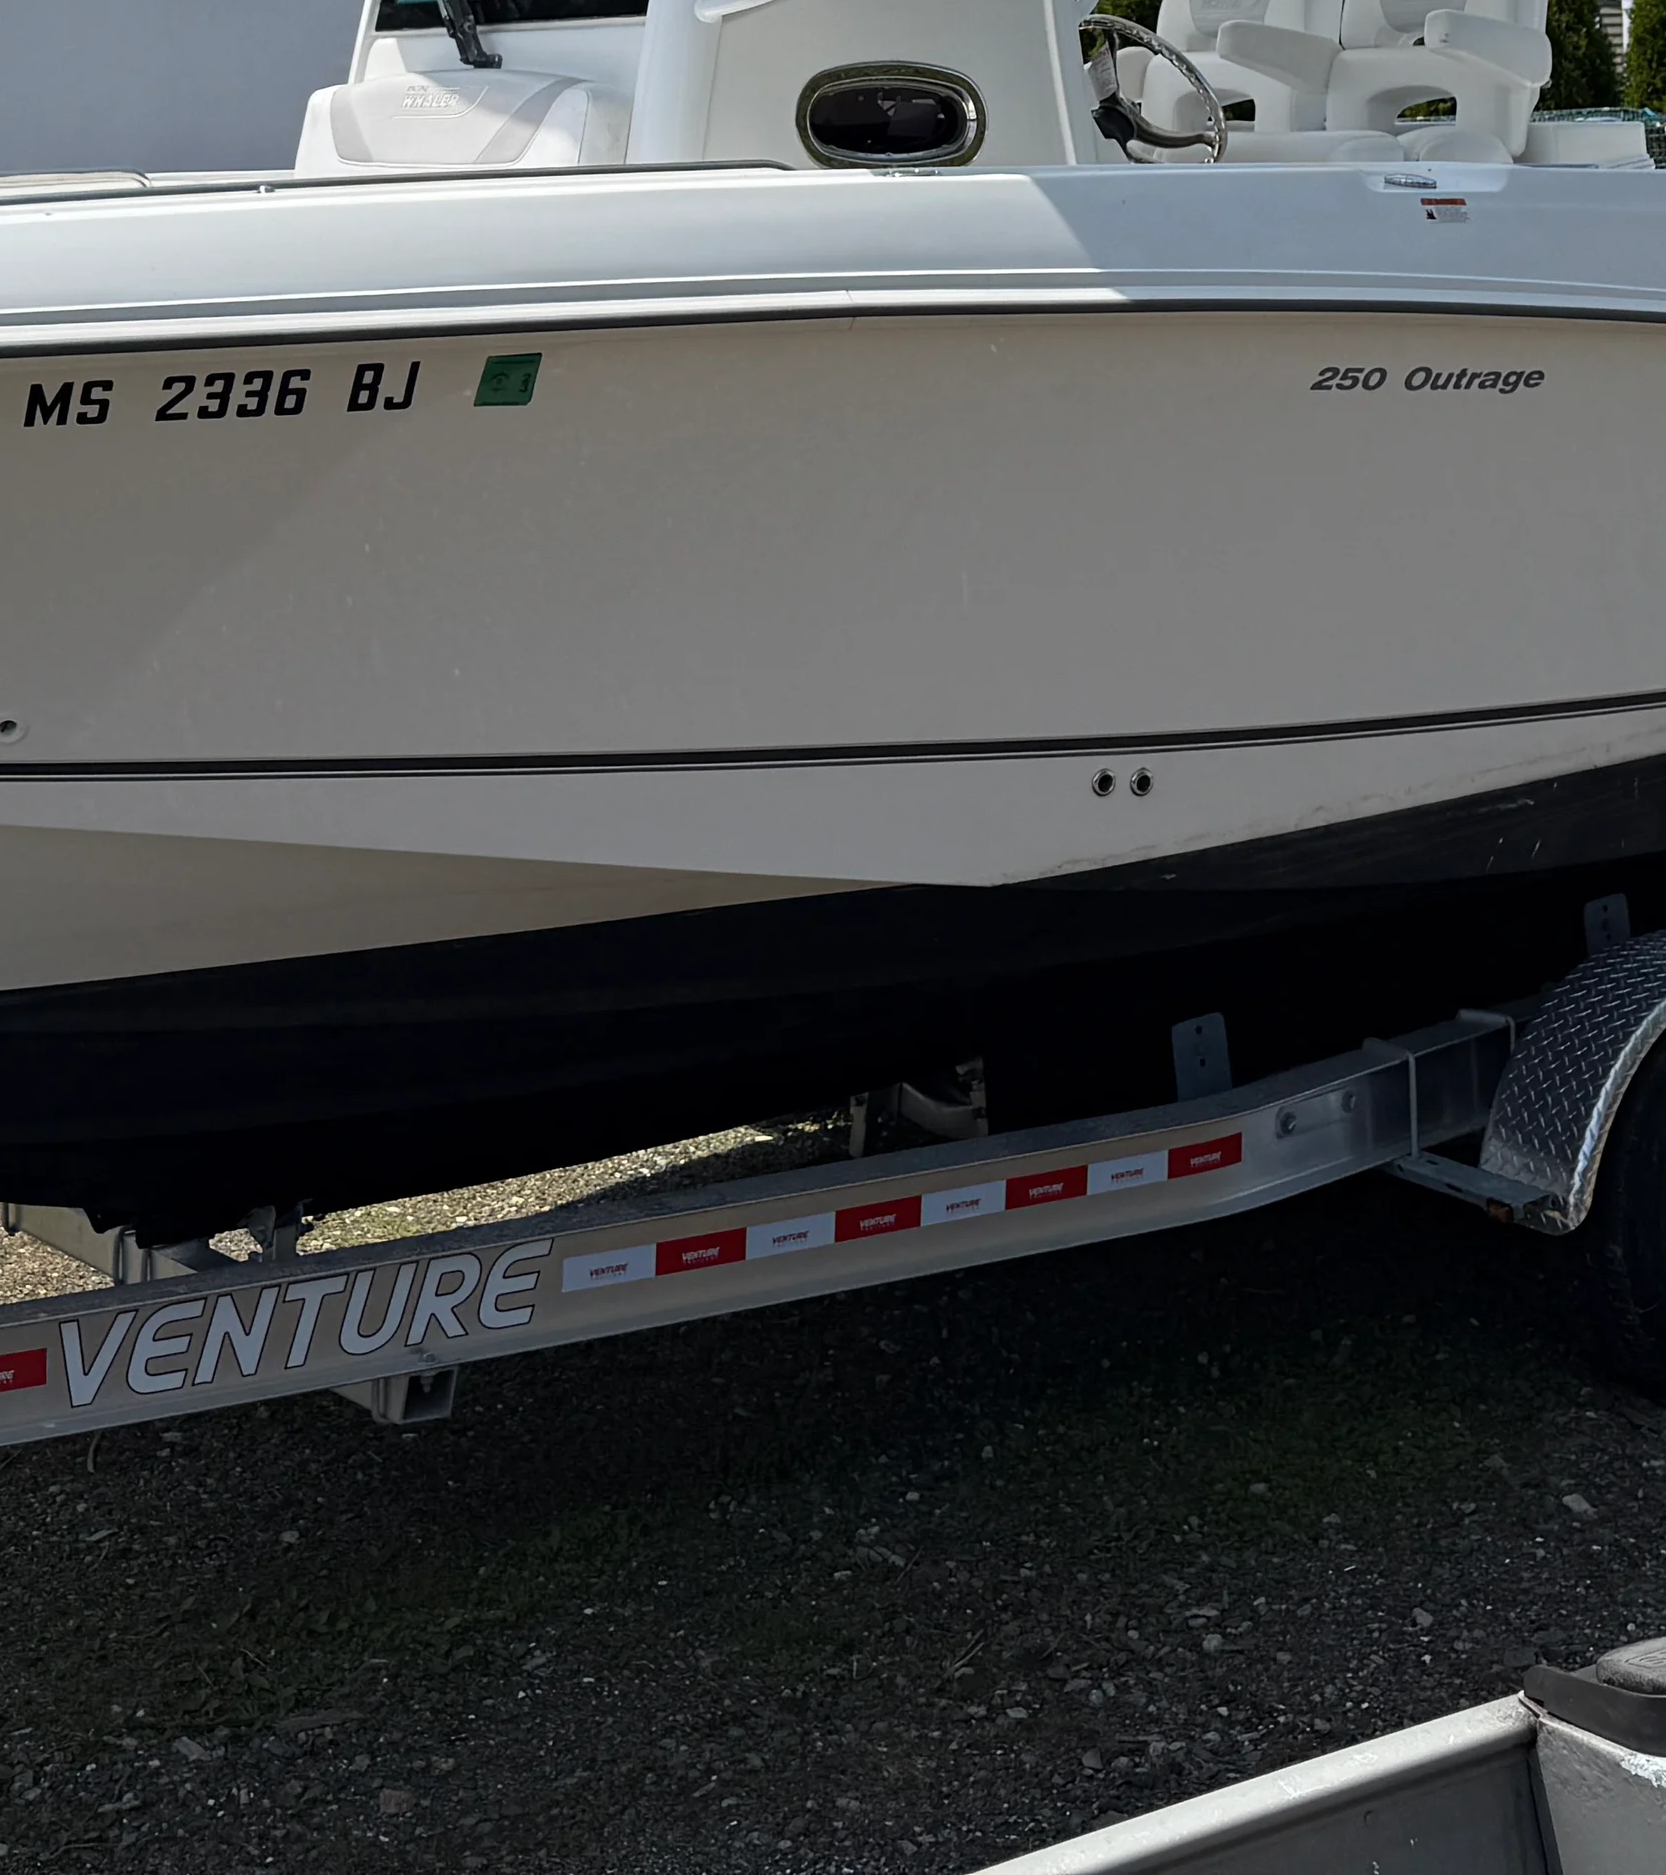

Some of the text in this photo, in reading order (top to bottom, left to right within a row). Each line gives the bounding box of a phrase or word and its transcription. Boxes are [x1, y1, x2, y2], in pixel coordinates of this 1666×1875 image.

[23, 361, 421, 428] MS 2336 BJ
[1309, 366, 1546, 395] 250 Outrage
[58, 1238, 555, 1409] VENTURE
